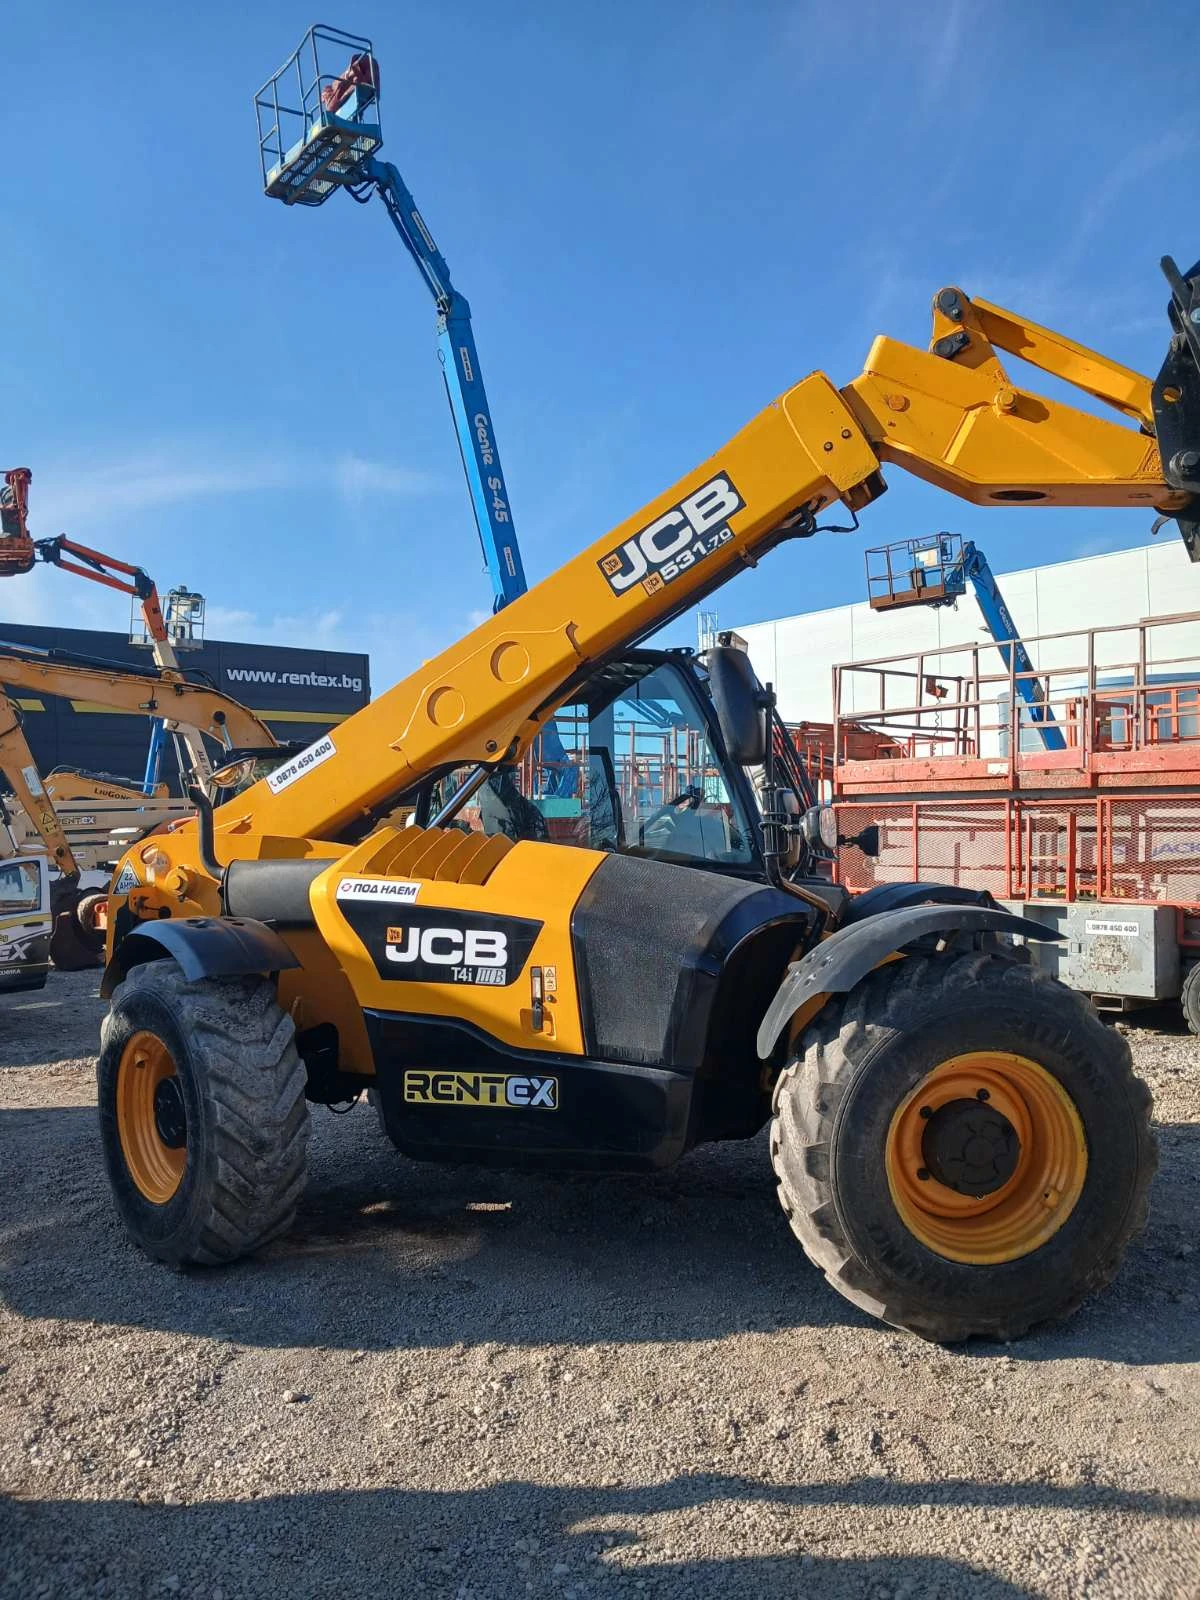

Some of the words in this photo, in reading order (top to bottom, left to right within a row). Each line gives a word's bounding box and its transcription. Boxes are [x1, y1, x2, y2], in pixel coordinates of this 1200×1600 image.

[473, 412, 494, 466] Genie
[488, 476, 510, 523] S-45
[609, 478, 740, 590] JCB
[659, 527, 732, 581] 531-70
[226, 668, 362, 692] www.rentex.bg
[276, 765, 298, 785] 0878
[297, 753, 315, 769] 450
[314, 741, 332, 758] 400
[353, 883, 378, 894] ПОД
[380, 885, 417, 896] НАЕМ
[386, 927, 508, 967] JCB
[451, 967, 473, 982] T4i
[406, 1073, 555, 1107] RENTEX
